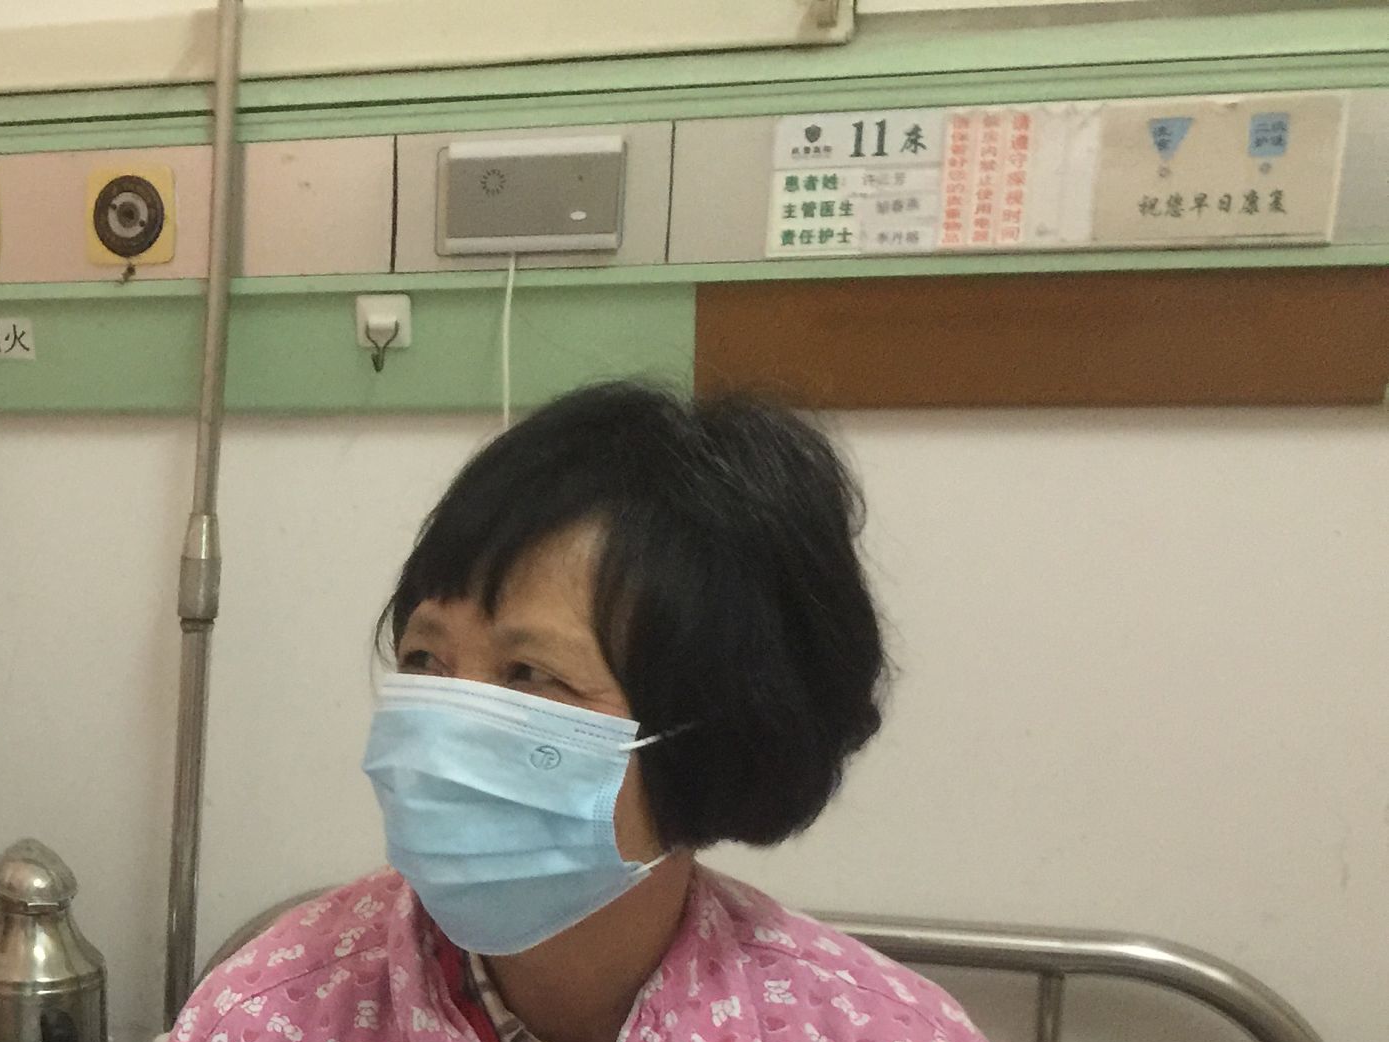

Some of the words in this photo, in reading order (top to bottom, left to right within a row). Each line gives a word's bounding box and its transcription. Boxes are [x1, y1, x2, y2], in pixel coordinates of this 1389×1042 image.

[782, 199, 854, 219] 主管医生
[1139, 189, 1287, 218] 祝您早日康复
[780, 226, 853, 246] 责任护士
